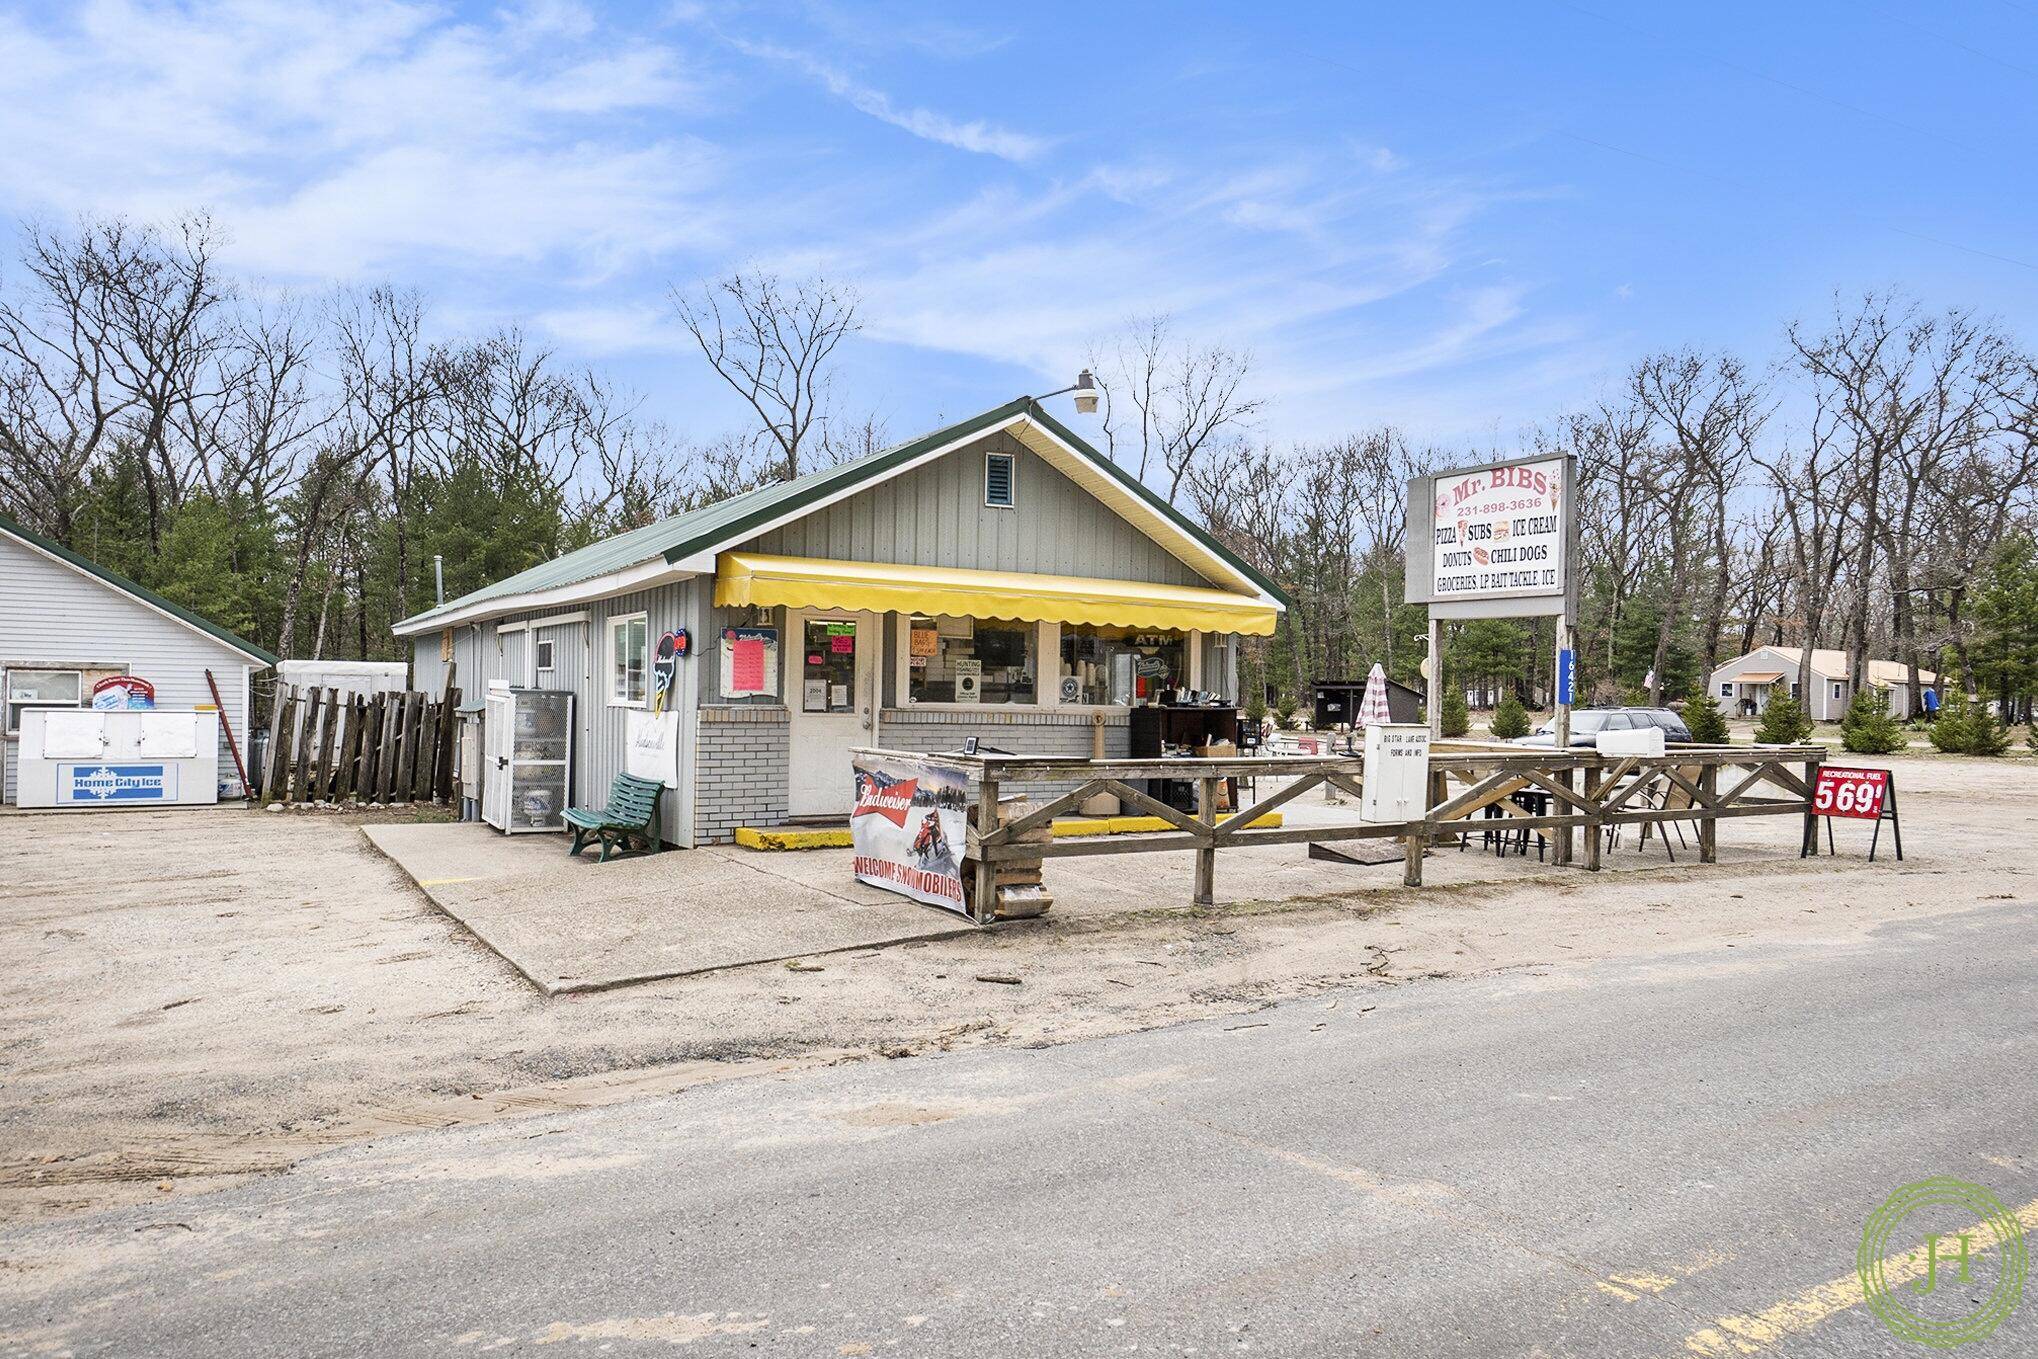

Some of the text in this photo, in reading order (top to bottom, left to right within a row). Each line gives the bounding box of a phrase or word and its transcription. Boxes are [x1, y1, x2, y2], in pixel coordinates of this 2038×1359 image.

[1452, 465, 1547, 506] Mr. BIBS
[1457, 497, 1543, 517] 231-898-3636
[1436, 515, 1557, 545] PIZZA SUBS ICE CREAM
[1443, 545, 1548, 567] DONUTS CHILI DOGS
[1542, 569, 1555, 586] ICE
[1135, 634, 1172, 646] ATM
[1567, 650, 1575, 702] 16421
[1392, 734, 1403, 743] STAR
[74, 778, 162, 788] Home City Ice
[1822, 770, 1882, 780] RECREATIONAL FUEL
[860, 783, 912, 811] Budweiser
